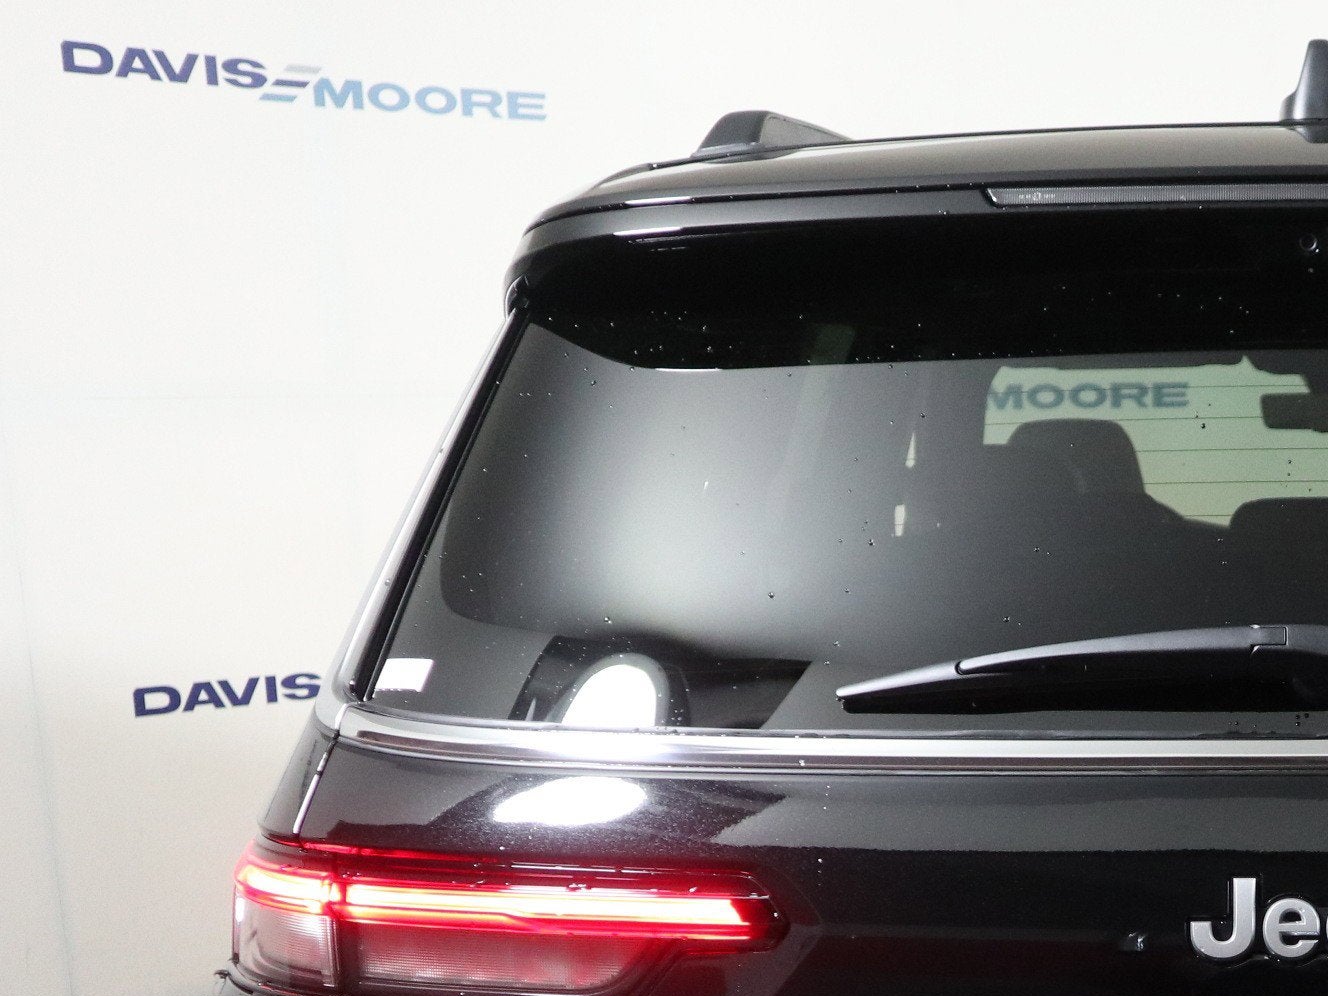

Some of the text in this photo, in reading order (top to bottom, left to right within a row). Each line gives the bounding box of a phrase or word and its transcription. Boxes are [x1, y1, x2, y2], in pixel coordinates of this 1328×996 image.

[60, 40, 548, 122] DAVIS MOORE
[133, 672, 321, 718] DAVIS
